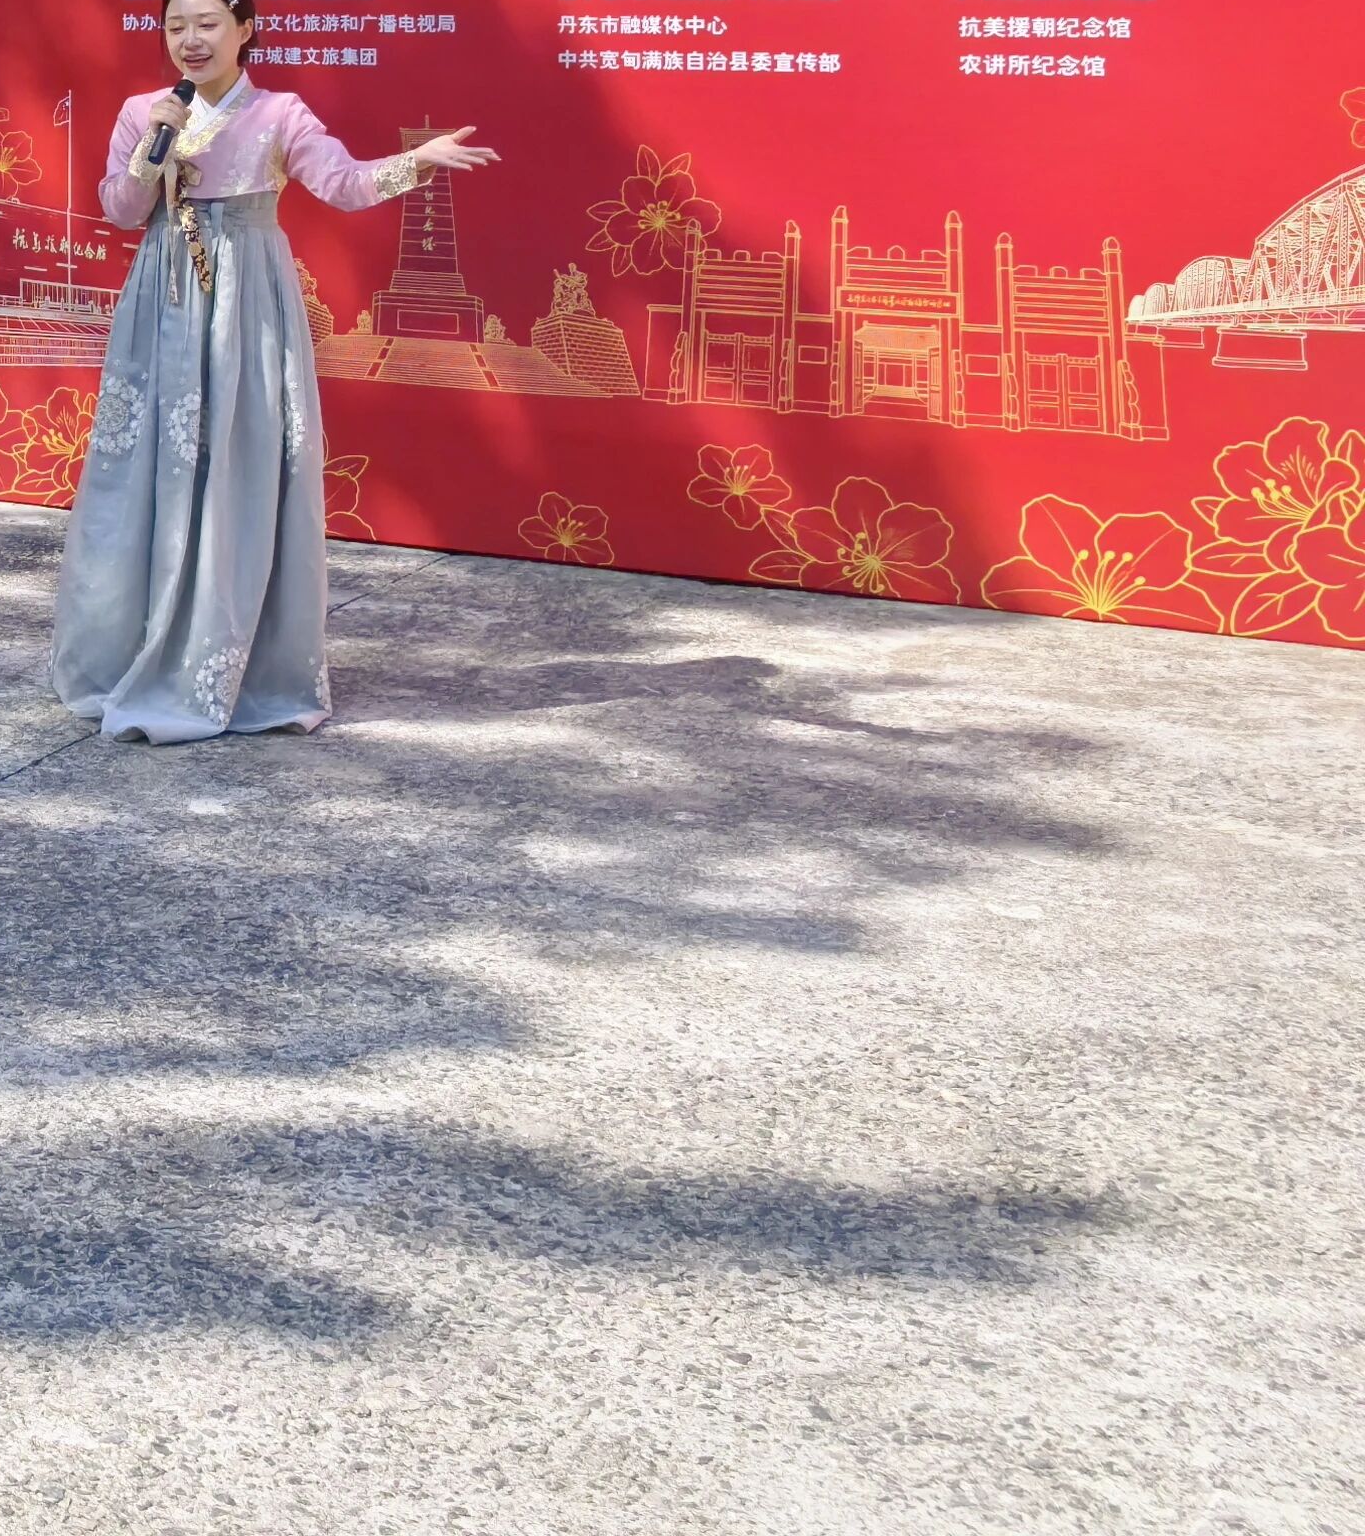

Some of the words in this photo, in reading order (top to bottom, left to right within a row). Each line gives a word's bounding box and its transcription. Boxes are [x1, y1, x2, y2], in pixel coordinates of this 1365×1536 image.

[557, 15, 728, 35] 丹东市融媒体中心
[958, 16, 1132, 39] 抗美援朝纪念馆
[248, 46, 377, 66] 市城建文旅集团
[557, 49, 841, 73] 中共宽甸满族自治县委宣传部
[958, 54, 1107, 77] 农讲所纪念馆
